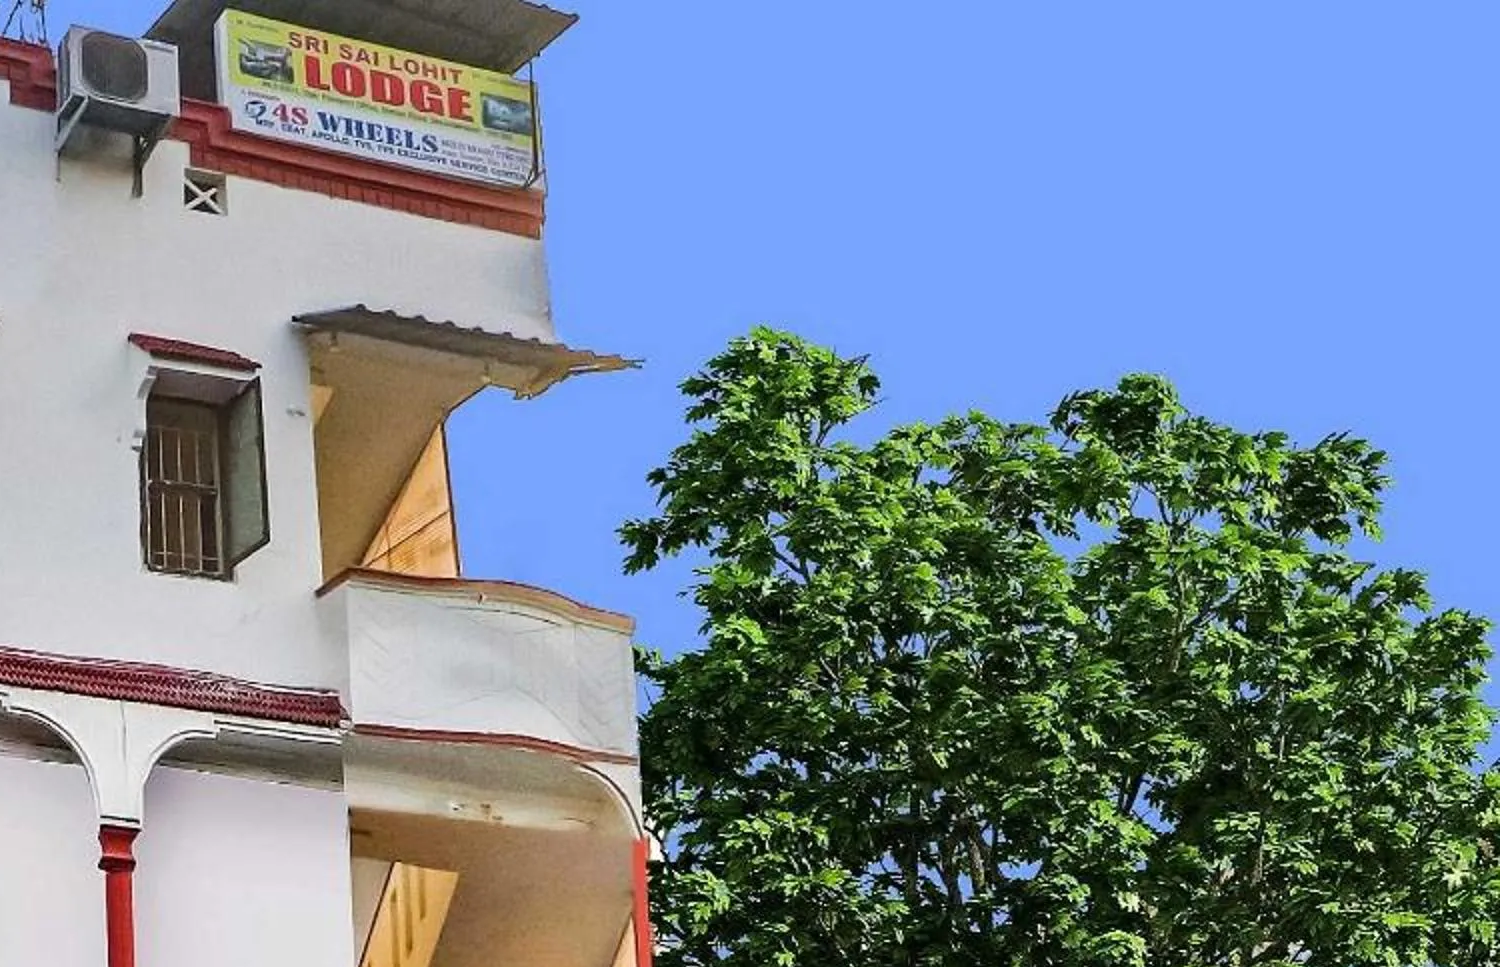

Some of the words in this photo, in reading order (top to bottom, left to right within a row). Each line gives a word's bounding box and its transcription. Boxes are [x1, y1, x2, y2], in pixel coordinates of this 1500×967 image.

[289, 31, 329, 54] SRI
[339, 43, 379, 66] SAI
[389, 55, 463, 84] LOHIT
[304, 54, 474, 122] LODGE
[273, 103, 309, 125] 4S
[316, 111, 439, 153] WHEELS
